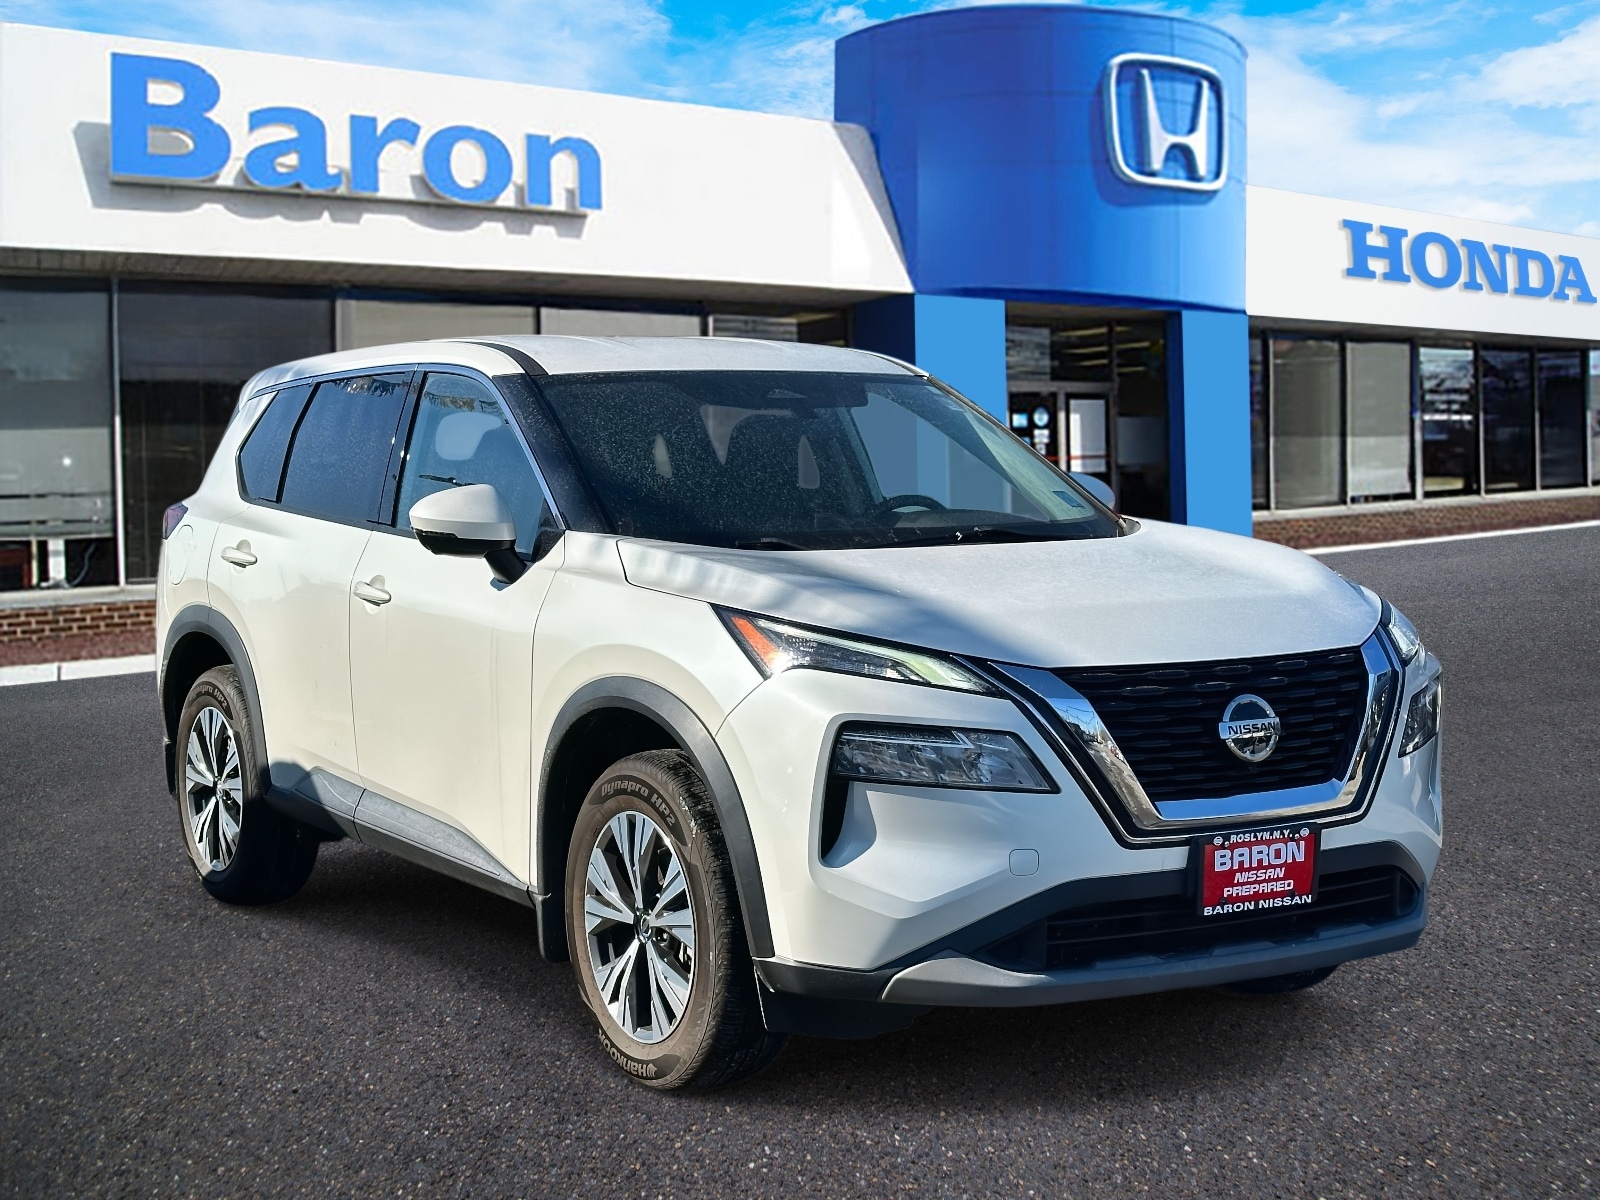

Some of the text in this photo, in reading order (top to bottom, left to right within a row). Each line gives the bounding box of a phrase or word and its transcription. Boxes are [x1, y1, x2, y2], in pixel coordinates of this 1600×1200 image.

[110, 52, 603, 211] Baron
[1342, 218, 1598, 304] HONDA
[1227, 721, 1276, 736] NISSAN
[601, 780, 676, 827] Dynapro HP2
[1214, 840, 1305, 872] BARON
[1233, 866, 1286, 884] NISSAN
[1223, 880, 1294, 898] PREPARED
[1203, 894, 1312, 916] BARON NISSAN
